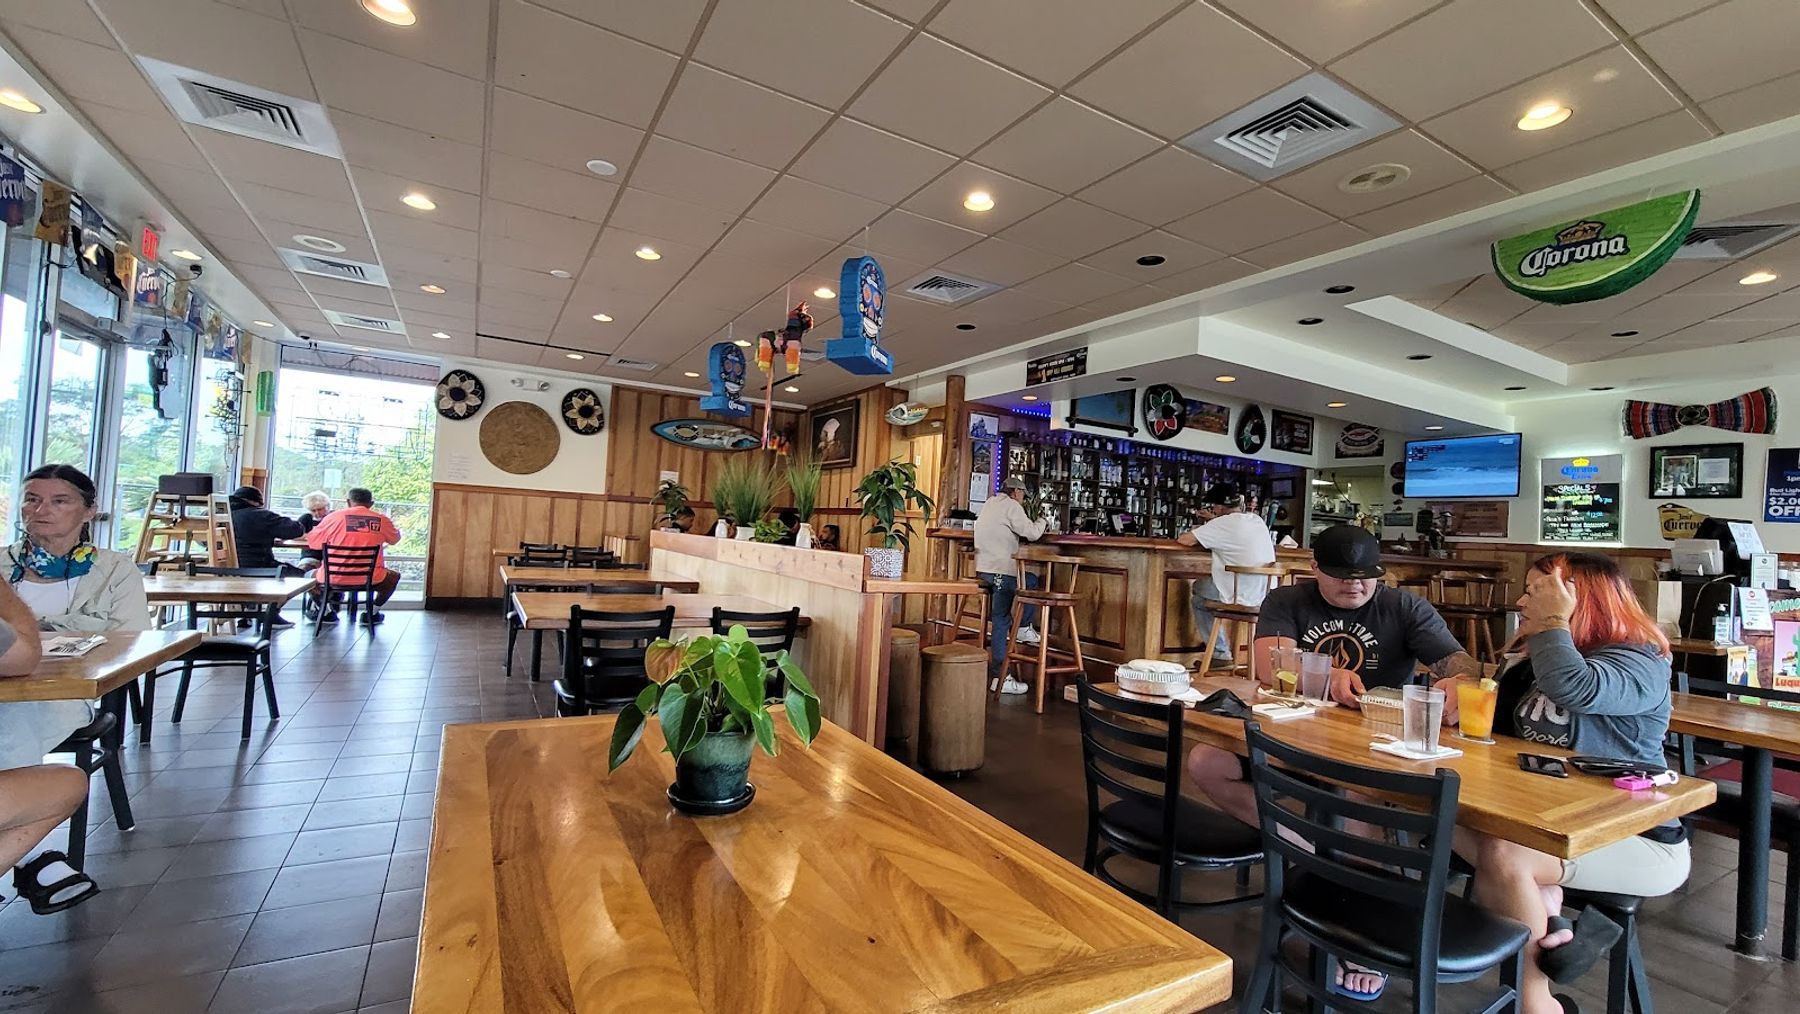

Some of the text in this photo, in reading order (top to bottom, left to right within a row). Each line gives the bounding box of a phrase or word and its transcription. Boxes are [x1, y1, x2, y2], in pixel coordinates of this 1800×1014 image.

[142, 227, 159, 261] EXIT
[1520, 235, 1627, 276] Corona
[1561, 465, 1599, 476] Corona
[1768, 505, 1800, 517] OFF
[1302, 619, 1344, 644] VOLCOM
